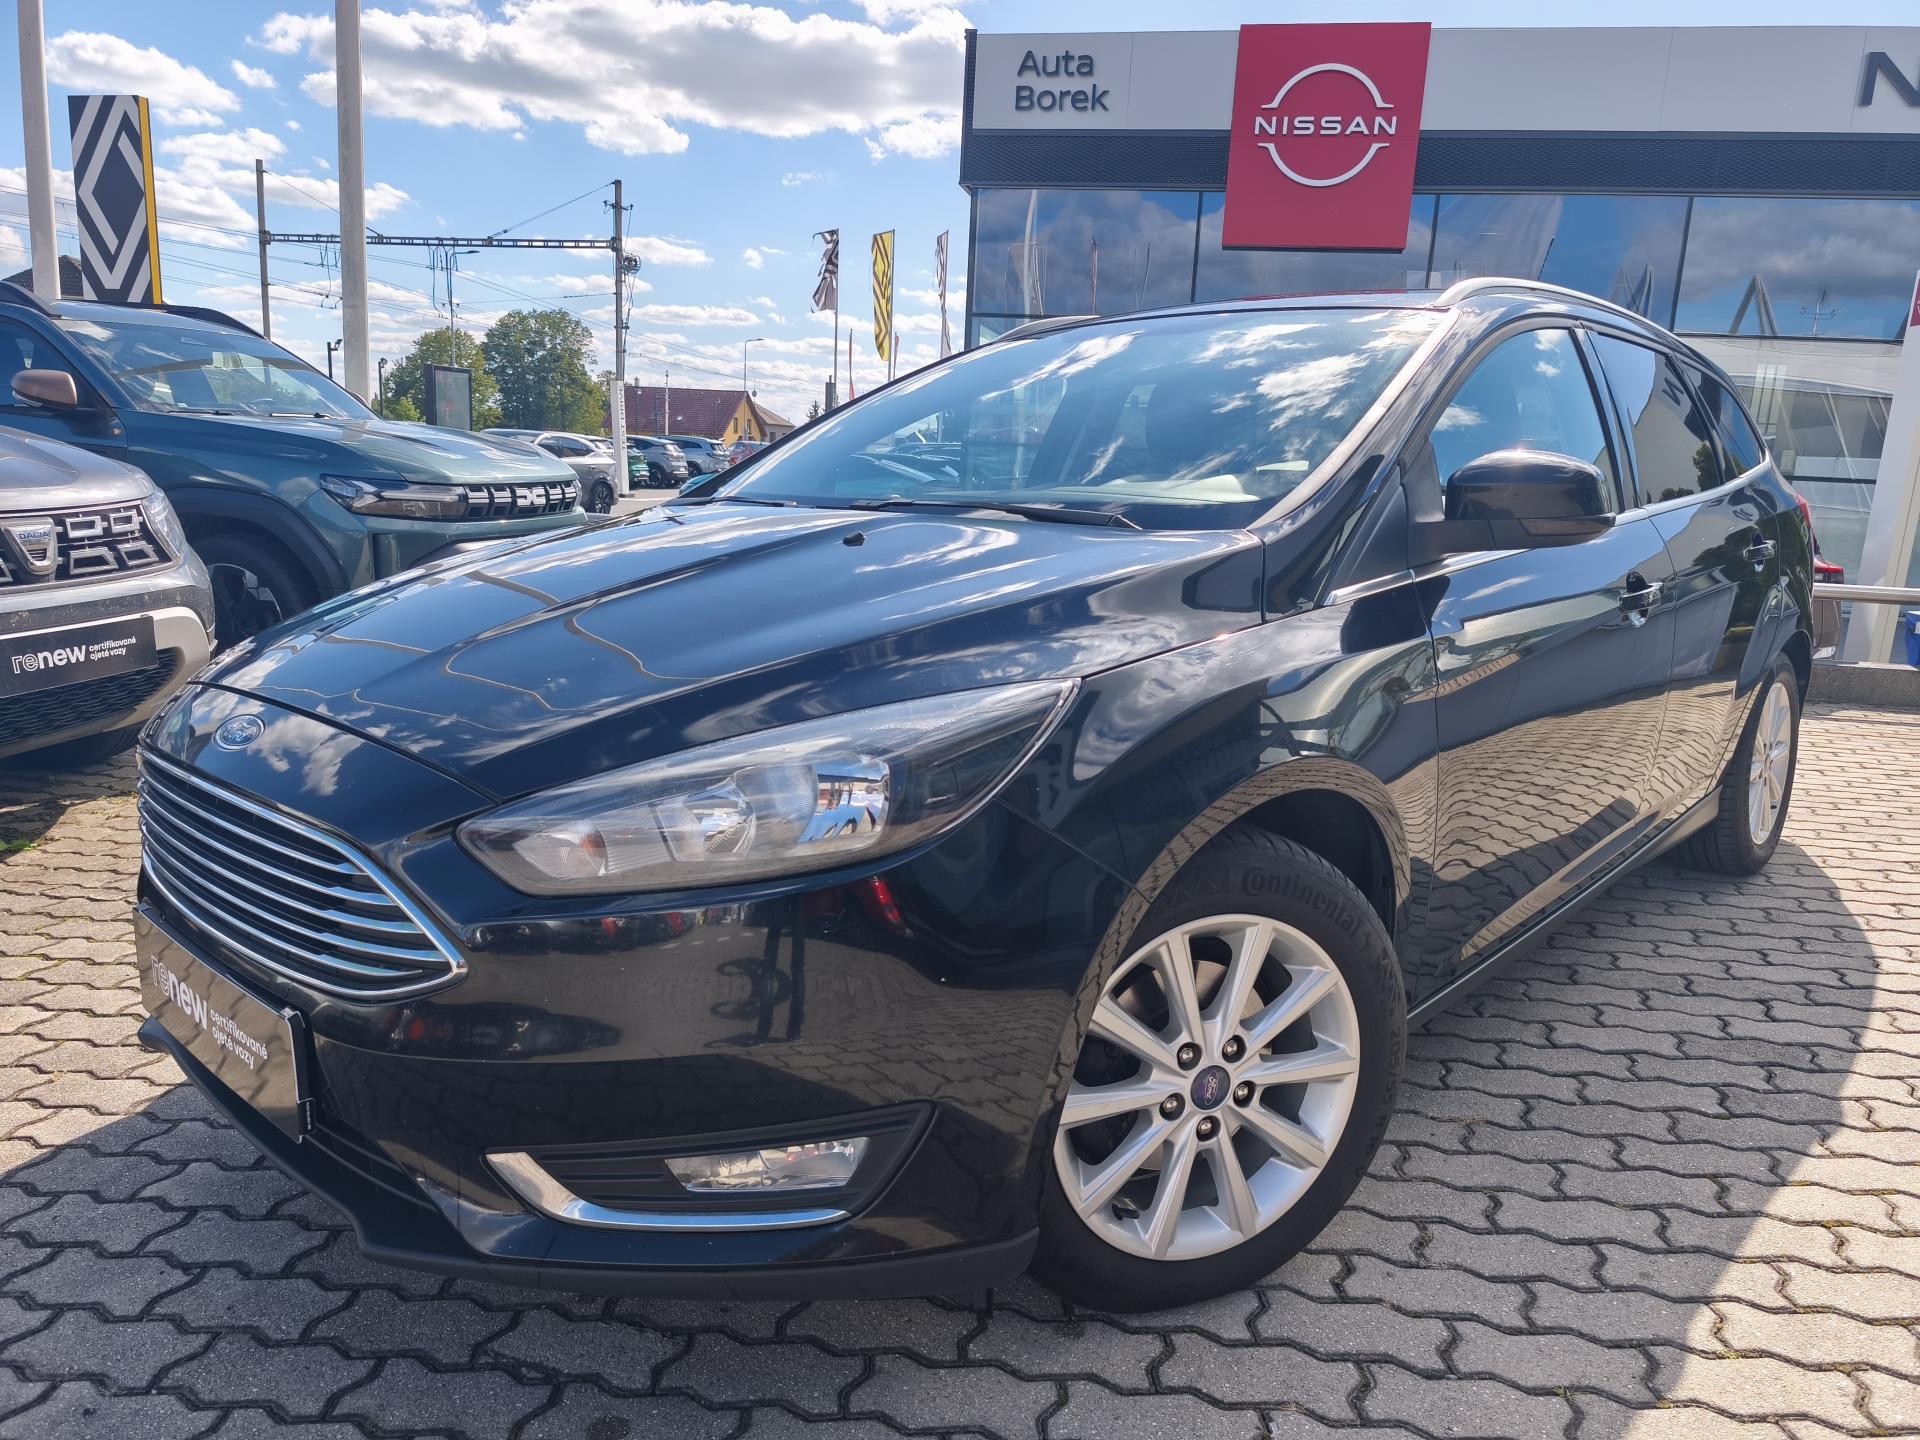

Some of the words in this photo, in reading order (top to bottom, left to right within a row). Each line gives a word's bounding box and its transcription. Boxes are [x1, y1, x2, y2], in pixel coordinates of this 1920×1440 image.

[1017, 50, 1094, 77] Auta
[1015, 83, 1110, 112] Borek
[1254, 116, 1397, 135] NISSAN
[19, 531, 49, 540] DACIA
[89, 636, 137, 652] certifikované
[90, 650, 110, 661] ojeté
[109, 646, 127, 656] vozy
[11, 645, 87, 674] renew
[1241, 867, 1362, 938] Continental
[150, 954, 208, 1030] renew
[210, 1009, 268, 1060] certifikované
[212, 1026, 234, 1051] ojeté
[233, 1041, 255, 1070] vozy
